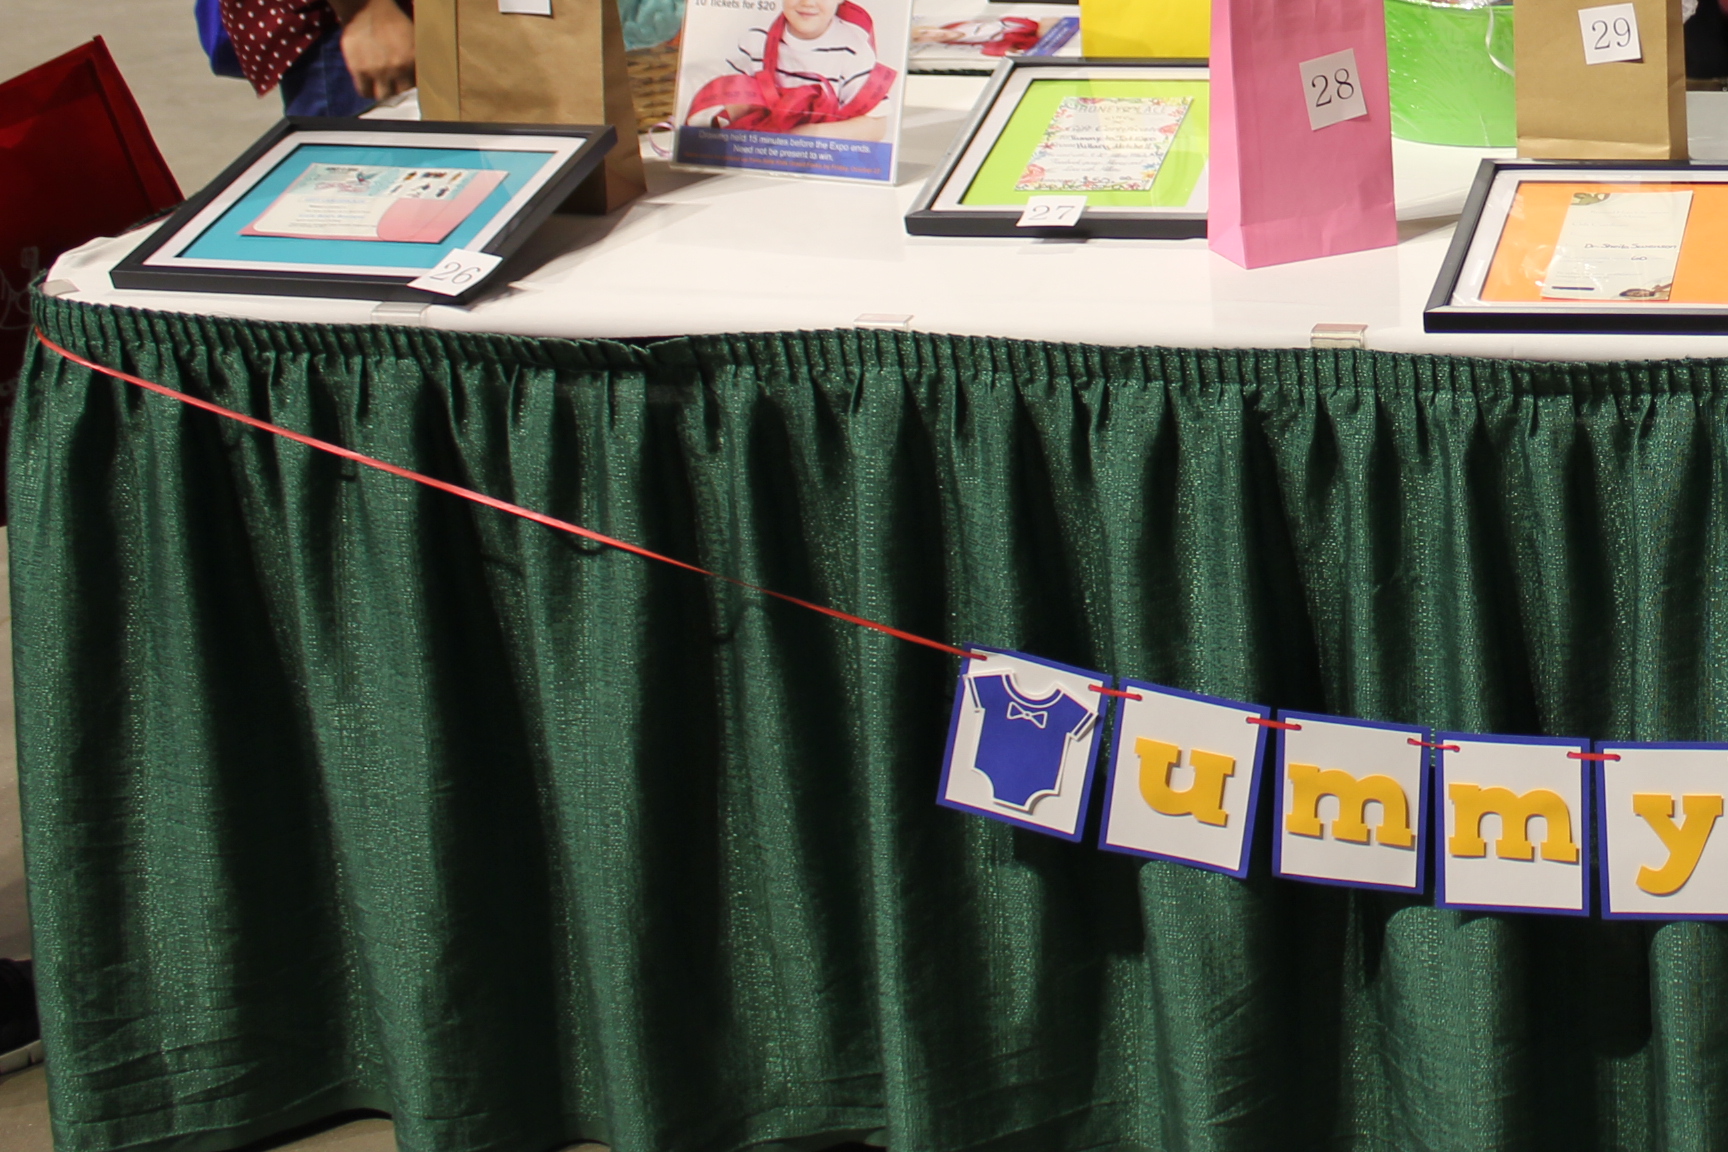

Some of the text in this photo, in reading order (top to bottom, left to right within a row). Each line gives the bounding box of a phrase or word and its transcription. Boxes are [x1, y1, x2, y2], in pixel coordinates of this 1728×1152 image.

[757, 0, 777, 12] $20
[1591, 17, 1632, 51] 29
[1311, 67, 1355, 108] 28
[730, 133, 747, 143] held
[759, 135, 788, 147] minutes
[789, 138, 814, 149] before
[815, 139, 828, 150] the
[829, 141, 849, 153] Expo
[733, 144, 753, 155] Need
[755, 146, 767, 156] not
[768, 147, 778, 157] be
[779, 148, 808, 161] present
[809, 150, 817, 159] to
[1028, 204, 1076, 221] 27
[429, 262, 481, 285] 26
